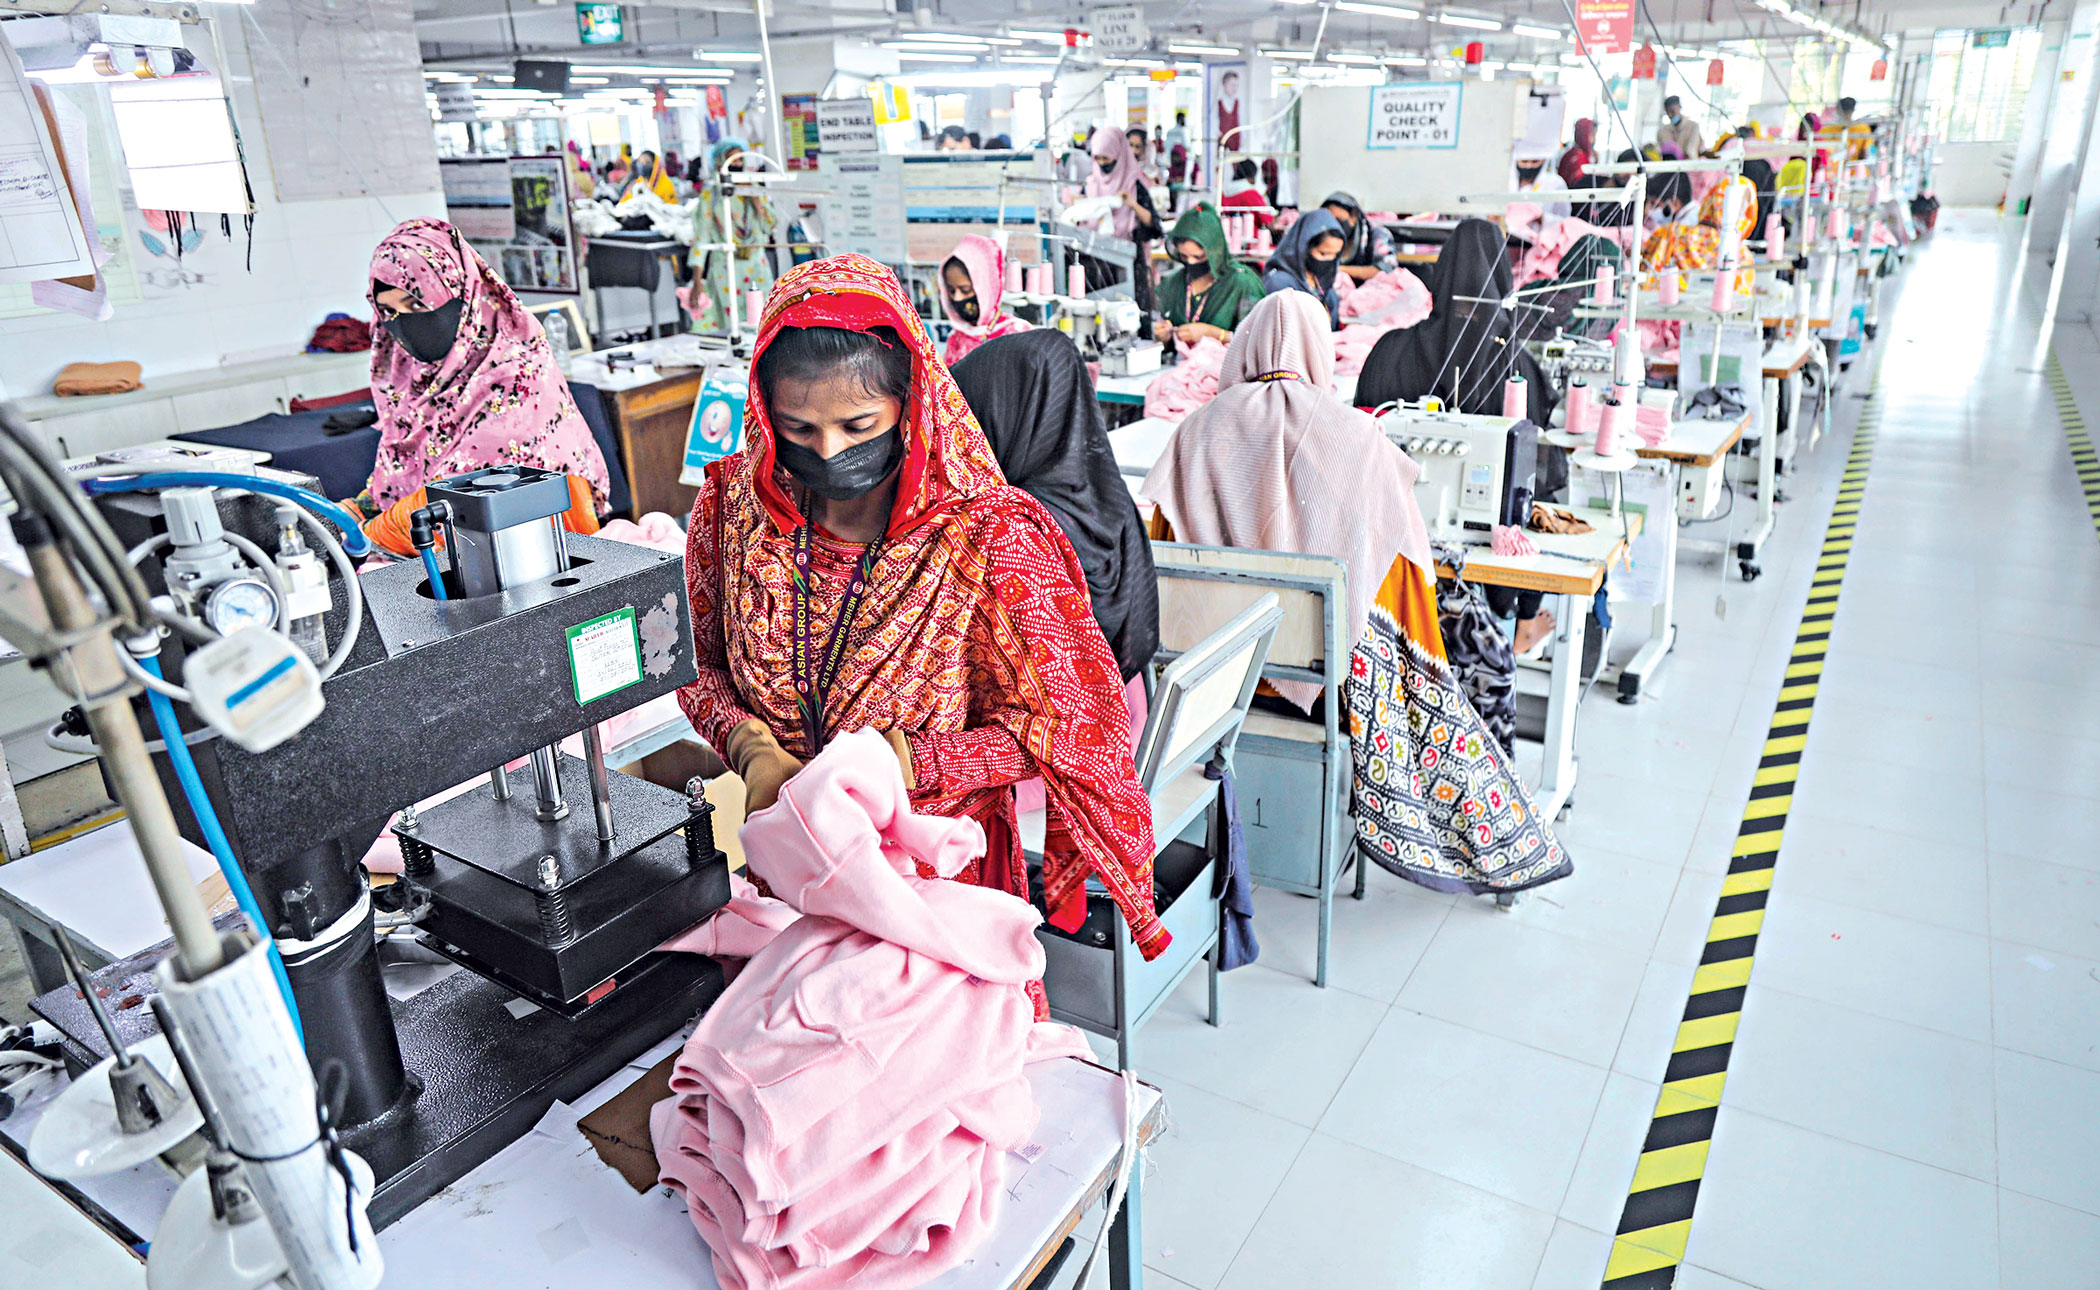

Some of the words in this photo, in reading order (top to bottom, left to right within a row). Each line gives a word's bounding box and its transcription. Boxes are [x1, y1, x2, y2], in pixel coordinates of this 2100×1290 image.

[1384, 101, 1446, 114] QUALITY
[820, 118, 839, 127] END
[843, 116, 872, 126] TABLE
[1389, 115, 1438, 127] CHECK
[823, 131, 874, 142] INSPECTION
[1377, 129, 1419, 140] POINT
[1433, 129, 1449, 140] 01
[799, 519, 808, 549] MEHE
[796, 593, 807, 638] GROUP
[842, 595, 858, 626] MEHER
[581, 617, 613, 635] INSPECTED
[613, 614, 621, 623] BY
[796, 640, 807, 678] ASIAN
[825, 627, 847, 672] GARMENTS
[1251, 797, 1269, 829] 1
